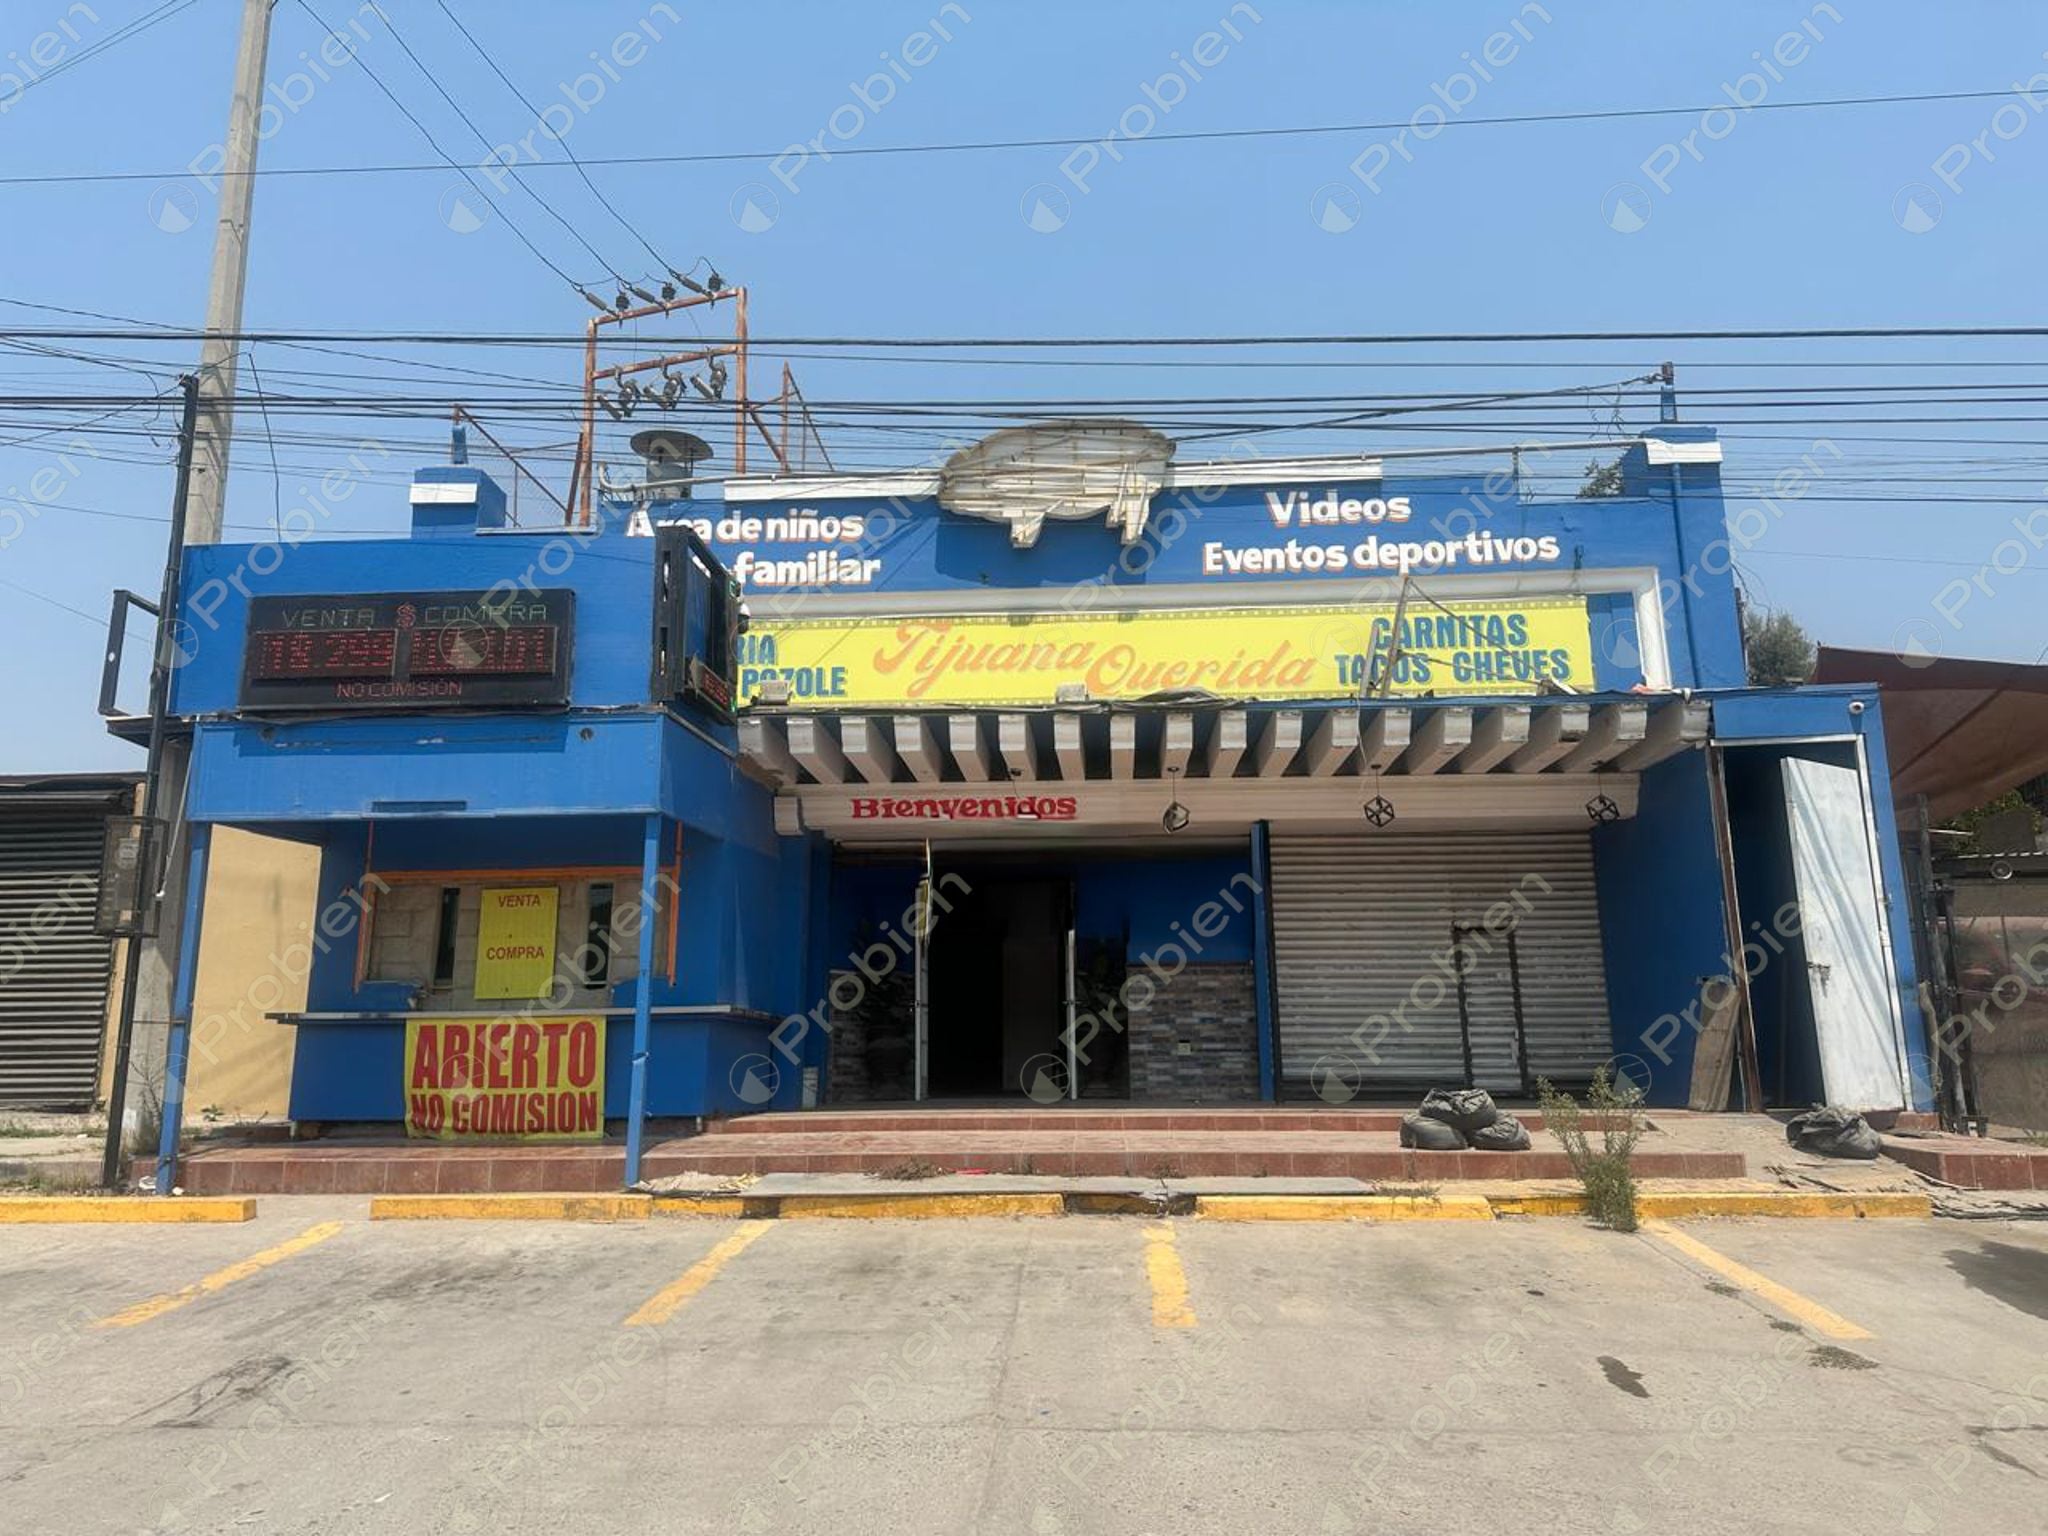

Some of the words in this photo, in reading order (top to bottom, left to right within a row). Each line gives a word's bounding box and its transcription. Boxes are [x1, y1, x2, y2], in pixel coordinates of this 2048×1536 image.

[715, 509, 763, 543] de
[764, 508, 865, 542] niños
[1265, 489, 1412, 527] Videos
[734, 550, 881, 586] familiar
[1203, 538, 1348, 575] Eventos
[1353, 530, 1561, 574] deportivos
[281, 608, 375, 628] VENTA
[424, 603, 547, 624] COMPRA
[1371, 613, 1529, 649] CARNITAS
[873, 619, 1096, 698] Tijuana
[1084, 639, 1318, 696] Querida
[1334, 652, 1432, 685] TACOS
[1452, 649, 1570, 683] CHEVES
[336, 683, 364, 698] NO
[851, 796, 1077, 820] Bienvenidos
[498, 894, 541, 908] VENTA
[487, 945, 545, 961] COMPRA
[412, 1020, 597, 1089] ABIERTO
[410, 1093, 445, 1135] NO
[451, 1090, 598, 1135] COMISION
